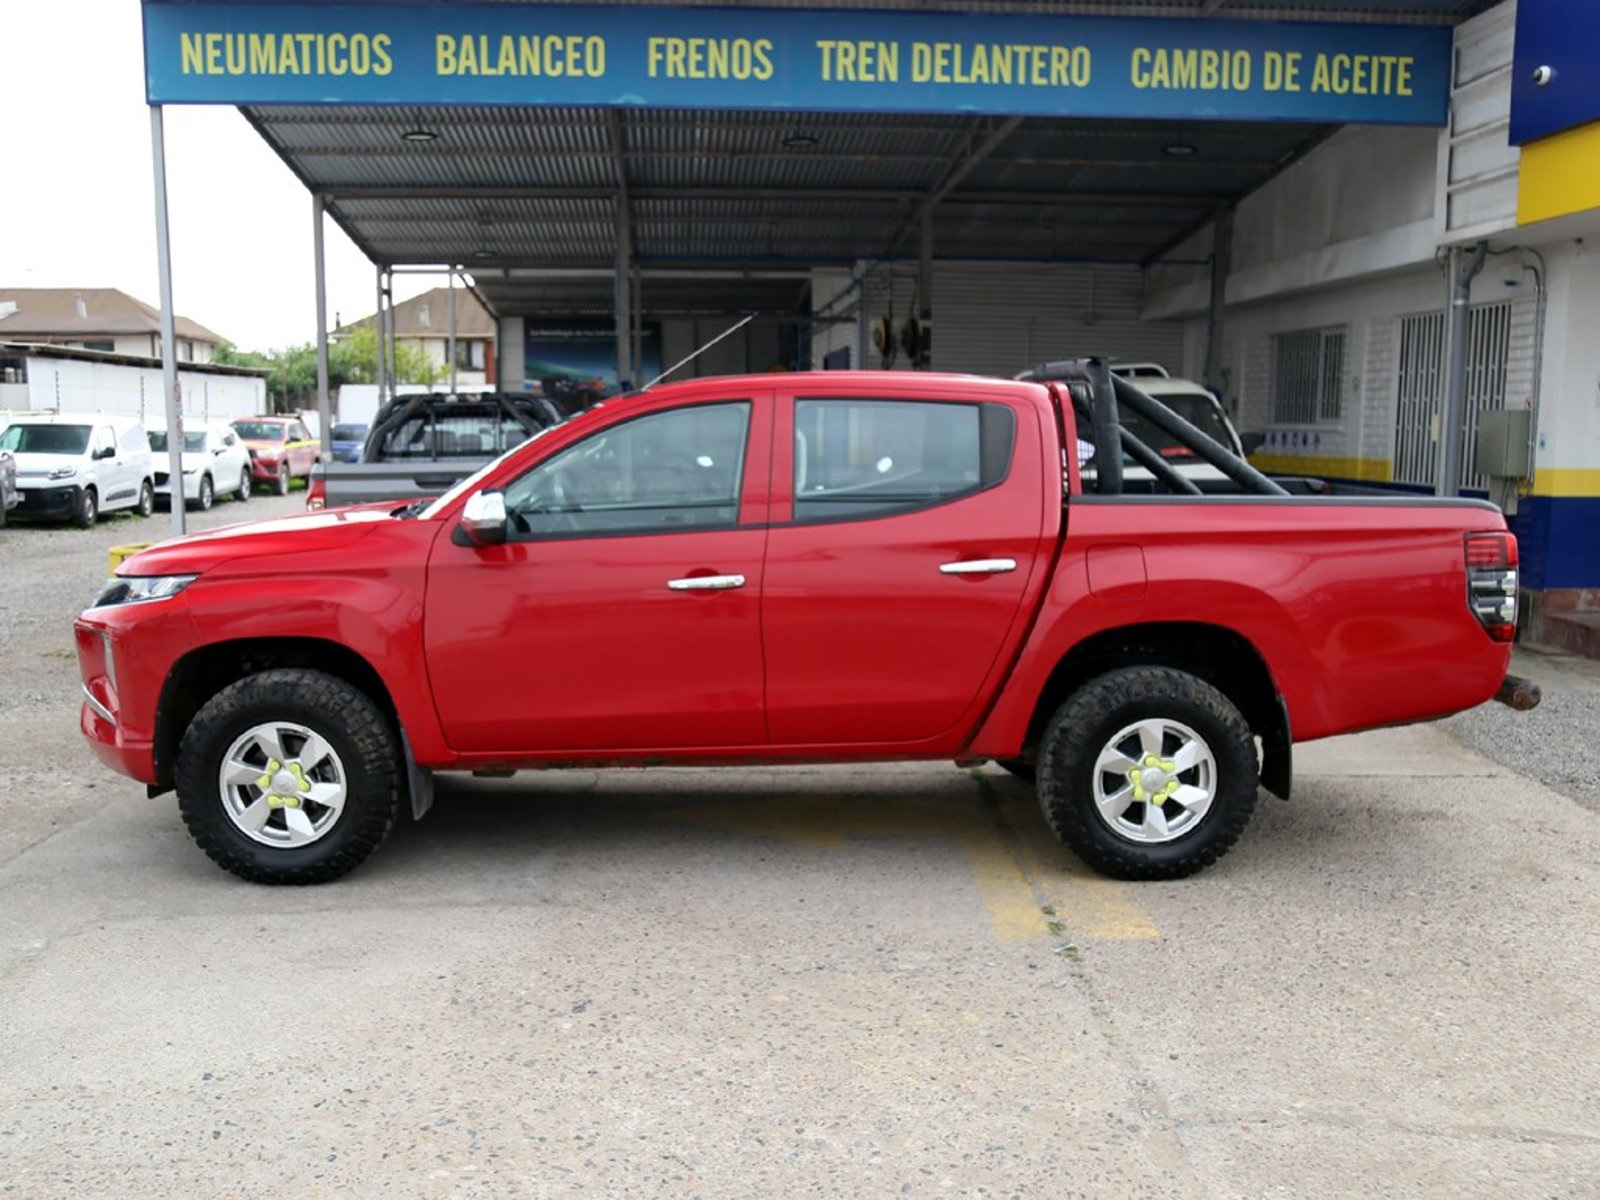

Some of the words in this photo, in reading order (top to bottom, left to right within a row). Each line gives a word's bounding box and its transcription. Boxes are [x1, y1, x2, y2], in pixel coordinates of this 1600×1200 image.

[181, 33, 393, 75] NEUMATICOS
[436, 35, 606, 77] BALANCEO
[648, 38, 773, 80] FRENOS
[817, 40, 898, 82] TREN
[912, 42, 1091, 87] DELANTERO
[1131, 47, 1251, 91] CAMBIO
[1264, 50, 1302, 92] DE
[1311, 54, 1413, 97] ACEITE
